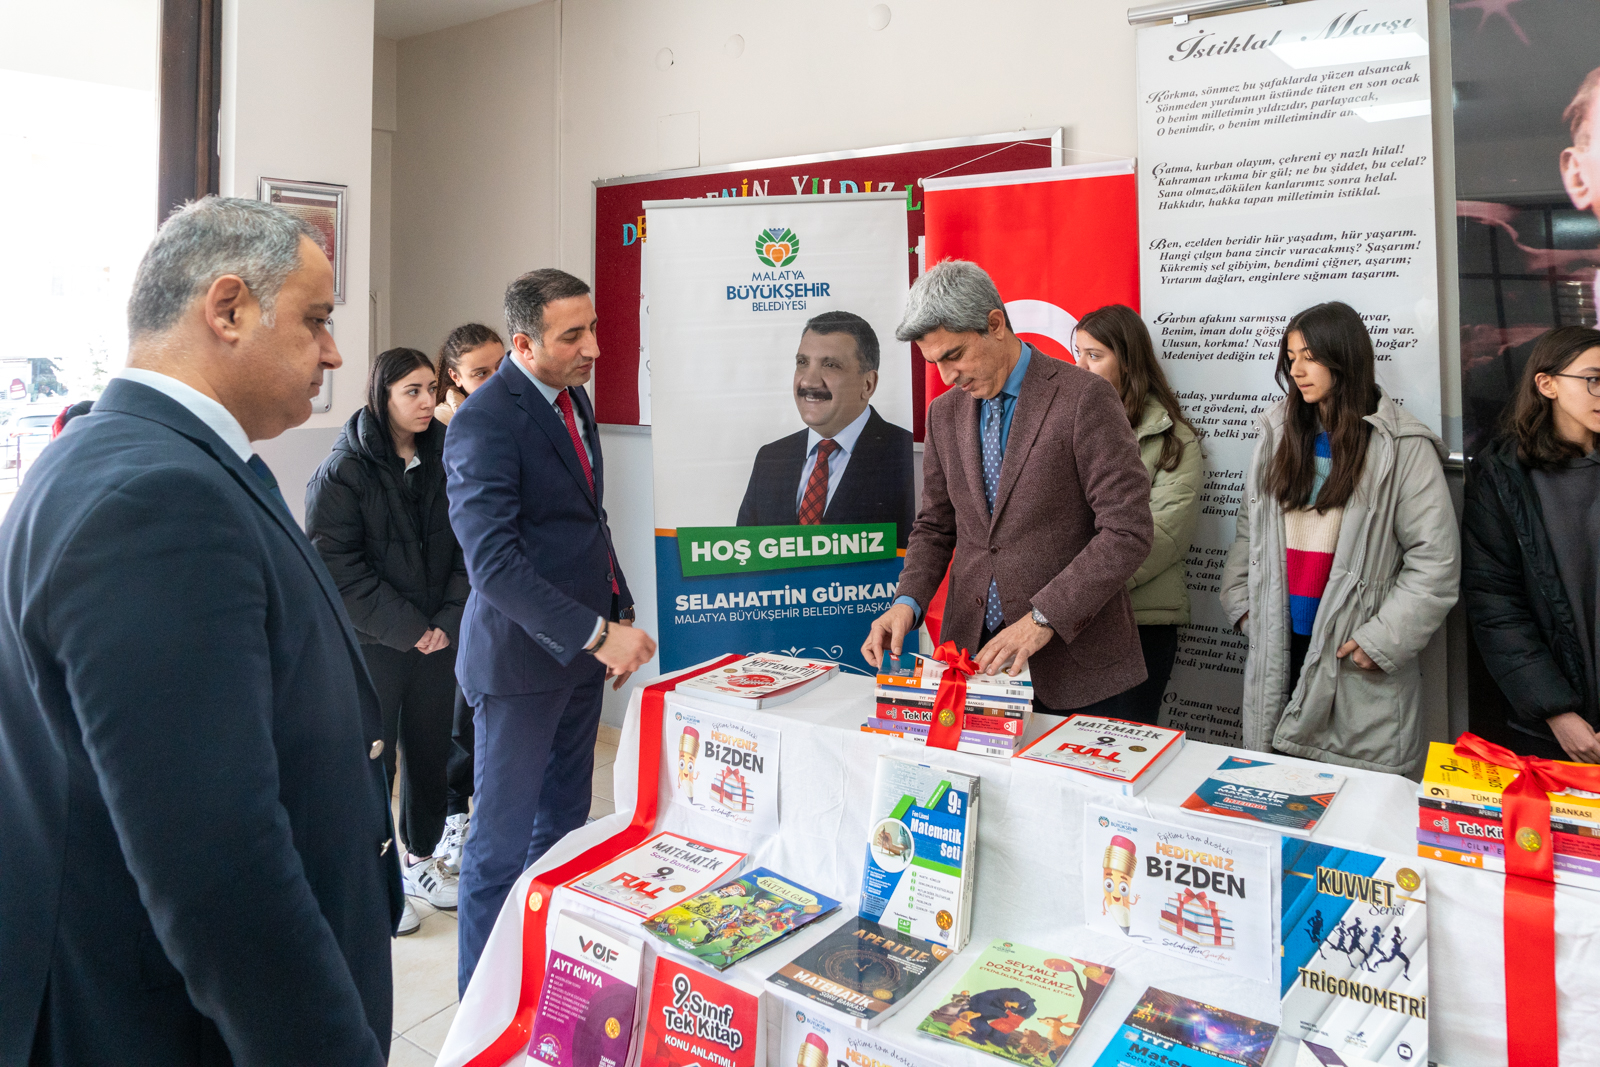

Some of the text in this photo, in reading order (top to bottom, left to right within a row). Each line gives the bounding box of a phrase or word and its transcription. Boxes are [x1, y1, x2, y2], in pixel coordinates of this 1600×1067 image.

[1168, 29, 1282, 62] İstiklal
[1146, 61, 1412, 104] Korkma, sönmez şafaklarda yüzen alsancak
[1156, 73, 1420, 113] Sönmeden yurdumun üstünde tüten ocak
[1168, 92, 1379, 124] benim milletimin yıldızıdır, parlayacak,
[1168, 108, 1338, 136] benimdir, benim milletimindir
[1152, 144, 1405, 180] Çatma, kurban olayım, çehreni nazlı hilal!
[1158, 156, 1427, 187] Kahraman ırkıma gül; şiddet, celal?
[1158, 172, 1398, 198] Sana kanlarımız sonra helal.
[1158, 186, 1380, 210] Hakkıdır, hakka tapan milletimin istiklal.
[1149, 228, 1416, 250] Ben, ezelden beridir hür yaşadım, hür yaşarım.
[1160, 240, 1421, 263] Hangi çılgın bana zincir vuracakmış? Şaşarım!
[752, 270, 805, 281] MALATYA
[1160, 255, 1412, 275] Kükremiş gibiyim, bendimi çiğner, aşarım;
[1160, 268, 1400, 285] Yırtarım dağları, enginlere sığmam taşarım.
[1153, 312, 1286, 325] Garbın afakını sarmışsa
[1161, 326, 1197, 336] Benim,
[1200, 326, 1226, 336] iman
[1229, 326, 1253, 335] dolu
[1161, 338, 1418, 350] Ulusun, korkma! Nasıl boğar?
[1161, 351, 1275, 362] Medeniyet dediğin tek
[691, 539, 752, 566] HOŞ
[675, 582, 900, 611] SELAHATTİN GÜRKAN
[675, 602, 894, 625] MALATYA BÜYÜKŞEHİR BELEDİYE BAŞKA
[902, 711, 920, 720] Tek
[1179, 698, 1240, 715] zaman vecd
[1073, 720, 1163, 740] MATEMATİK
[1055, 742, 1122, 764] FULL
[1471, 794, 1490, 803] TÜM
[1556, 806, 1592, 818] BANKASI
[911, 818, 962, 844] Matematik
[1456, 821, 1484, 836] Tek
[652, 842, 723, 871] MATEMATİK
[940, 842, 960, 861] Seti
[1460, 854, 1477, 864] AYT
[650, 852, 701, 874] Soru Bankası
[611, 872, 665, 899] FULL
[760, 879, 791, 896] BATTAL
[1316, 865, 1395, 908] KUVVET
[1368, 902, 1405, 917] Serisi
[553, 958, 573, 974] AYT
[573, 965, 602, 988] KİMYA
[986, 961, 1074, 991] DOSTLARIMIZ
[1005, 959, 1058, 978] SEVİMLİ
[793, 970, 875, 1008] MATEMATİK
[1025, 980, 1051, 991] BOYAMA
[1298, 966, 1426, 1020] TRİGONOMETRİ
[819, 990, 838, 1001] SORU
[837, 999, 866, 1012] BANKASI
[663, 1006, 743, 1050] Tek Kitap
[664, 1034, 690, 1052] KONU
[1141, 1033, 1174, 1050] TYT
[1125, 1052, 1149, 1064] Soru
